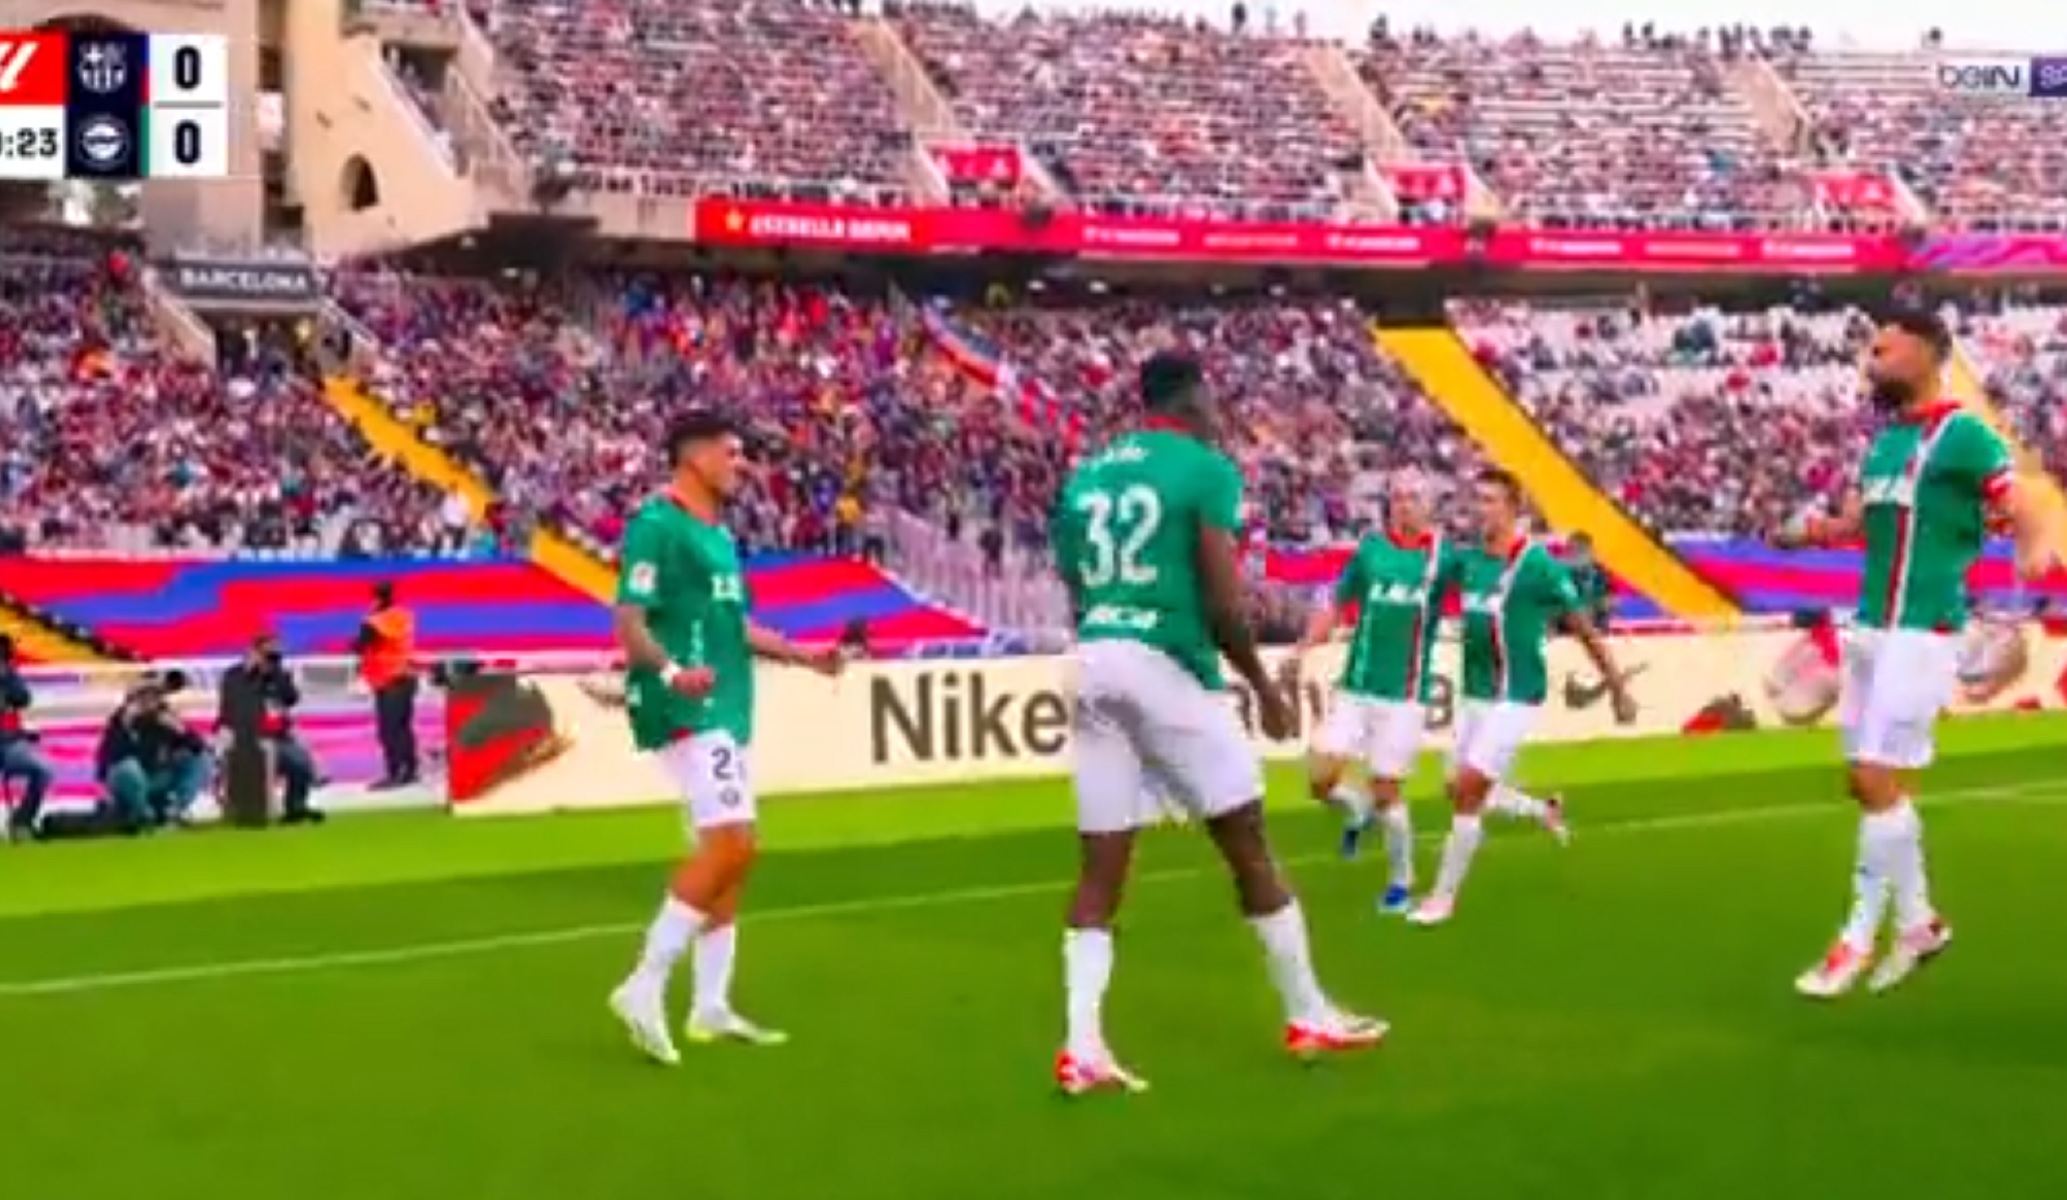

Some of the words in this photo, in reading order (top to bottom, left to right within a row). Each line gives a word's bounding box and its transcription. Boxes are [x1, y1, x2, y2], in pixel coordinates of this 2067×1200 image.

[180, 267, 307, 293] BARCELONA
[1077, 484, 1160, 588] 32
[871, 670, 1069, 764] Nike
